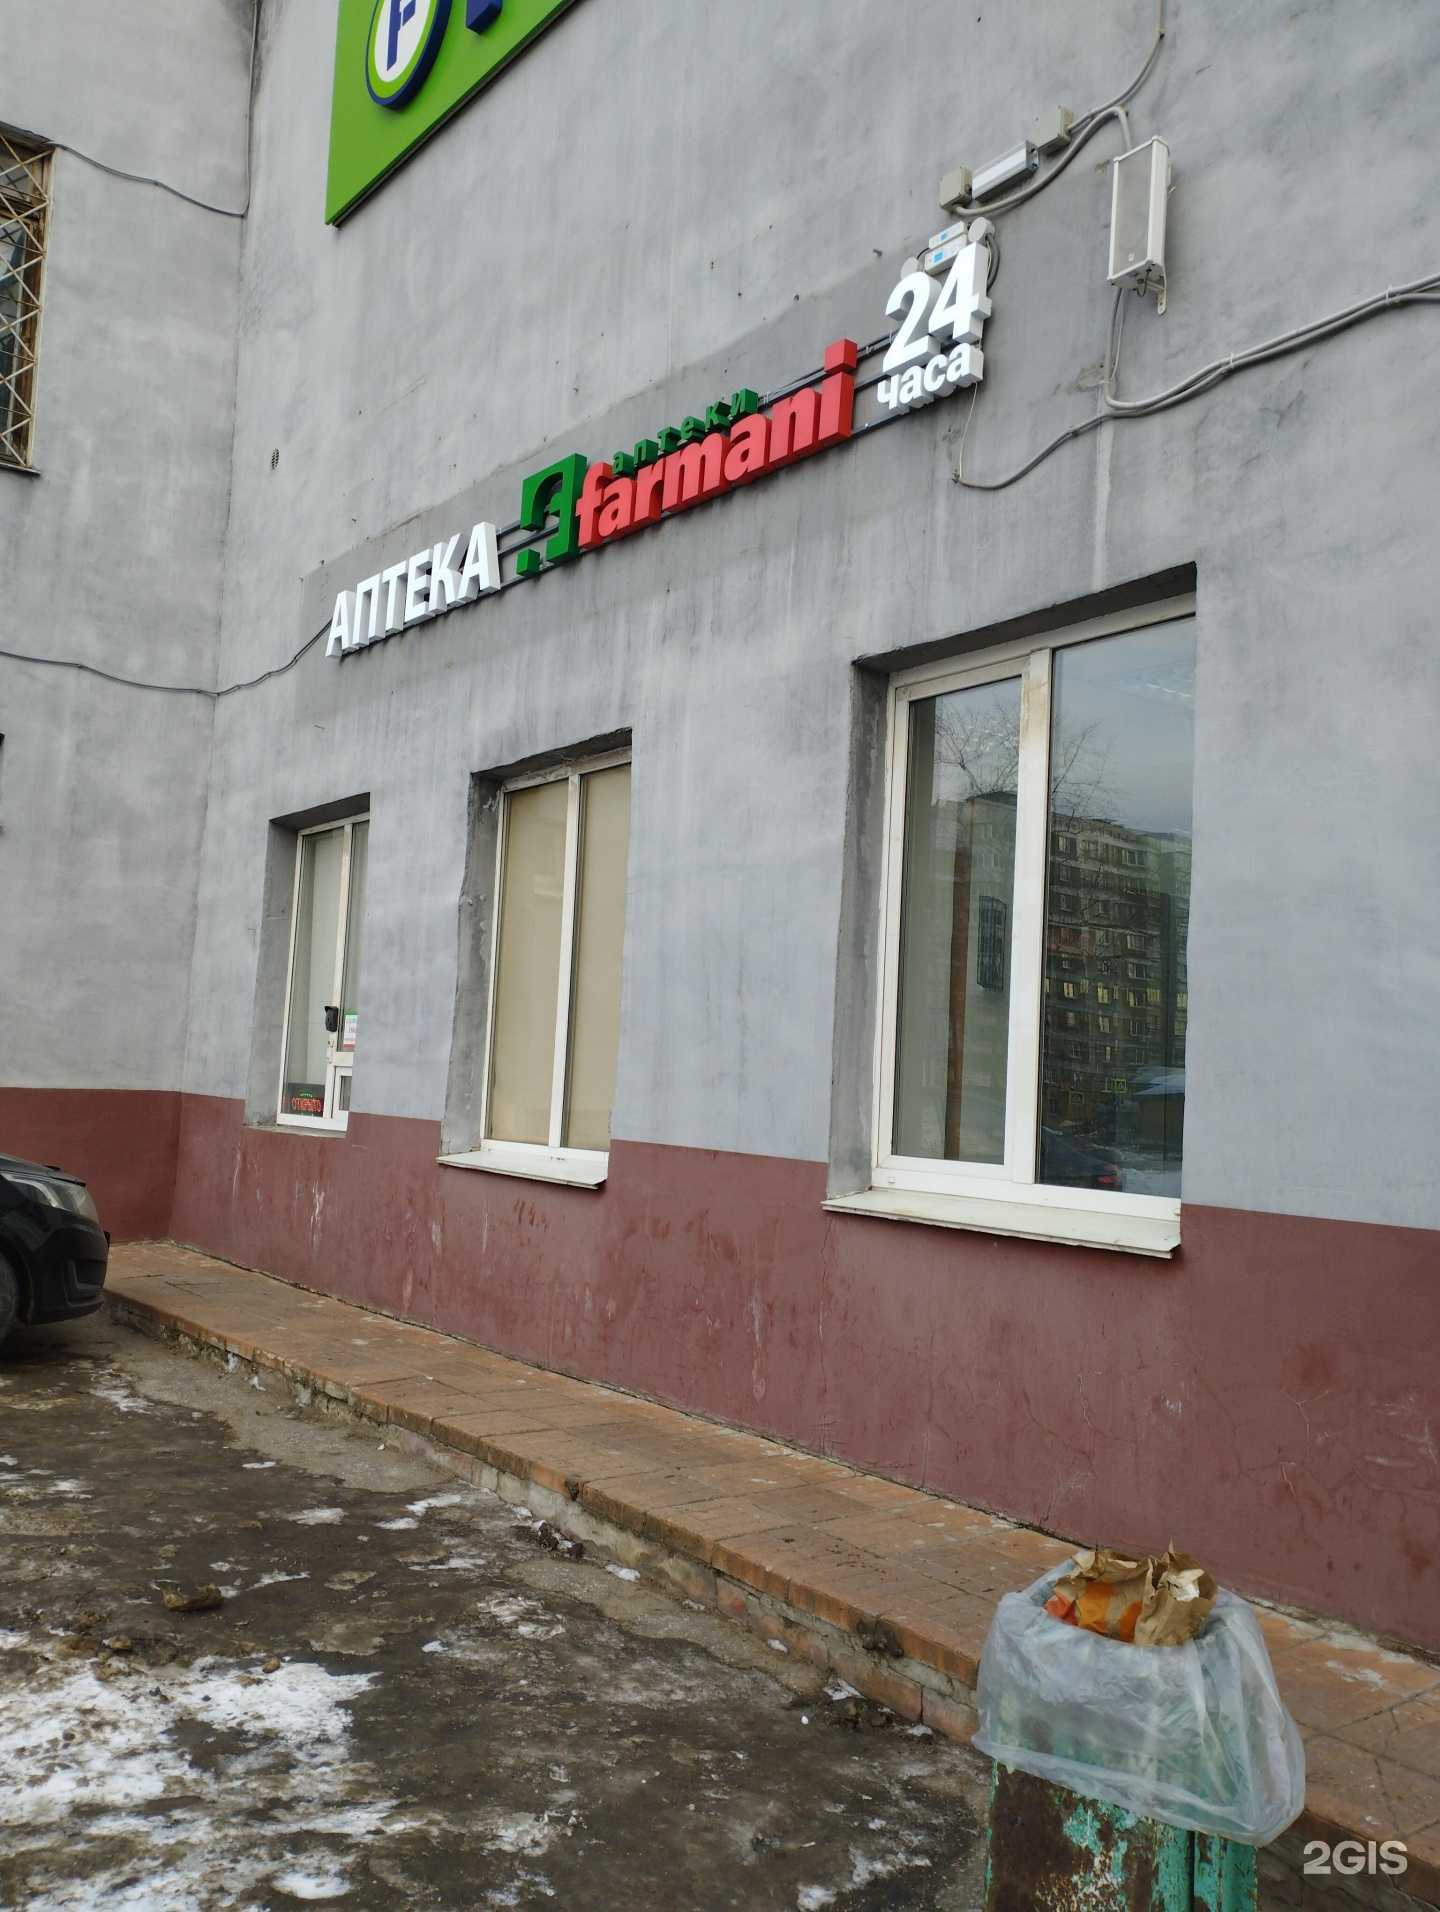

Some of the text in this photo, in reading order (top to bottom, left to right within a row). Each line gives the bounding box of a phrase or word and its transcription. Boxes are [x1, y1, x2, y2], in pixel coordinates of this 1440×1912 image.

[884, 241, 991, 373] 24
[613, 388, 759, 476] аптеки
[877, 343, 983, 408] часа
[575, 338, 858, 550] farmani
[325, 521, 500, 658] АПТЕКА
